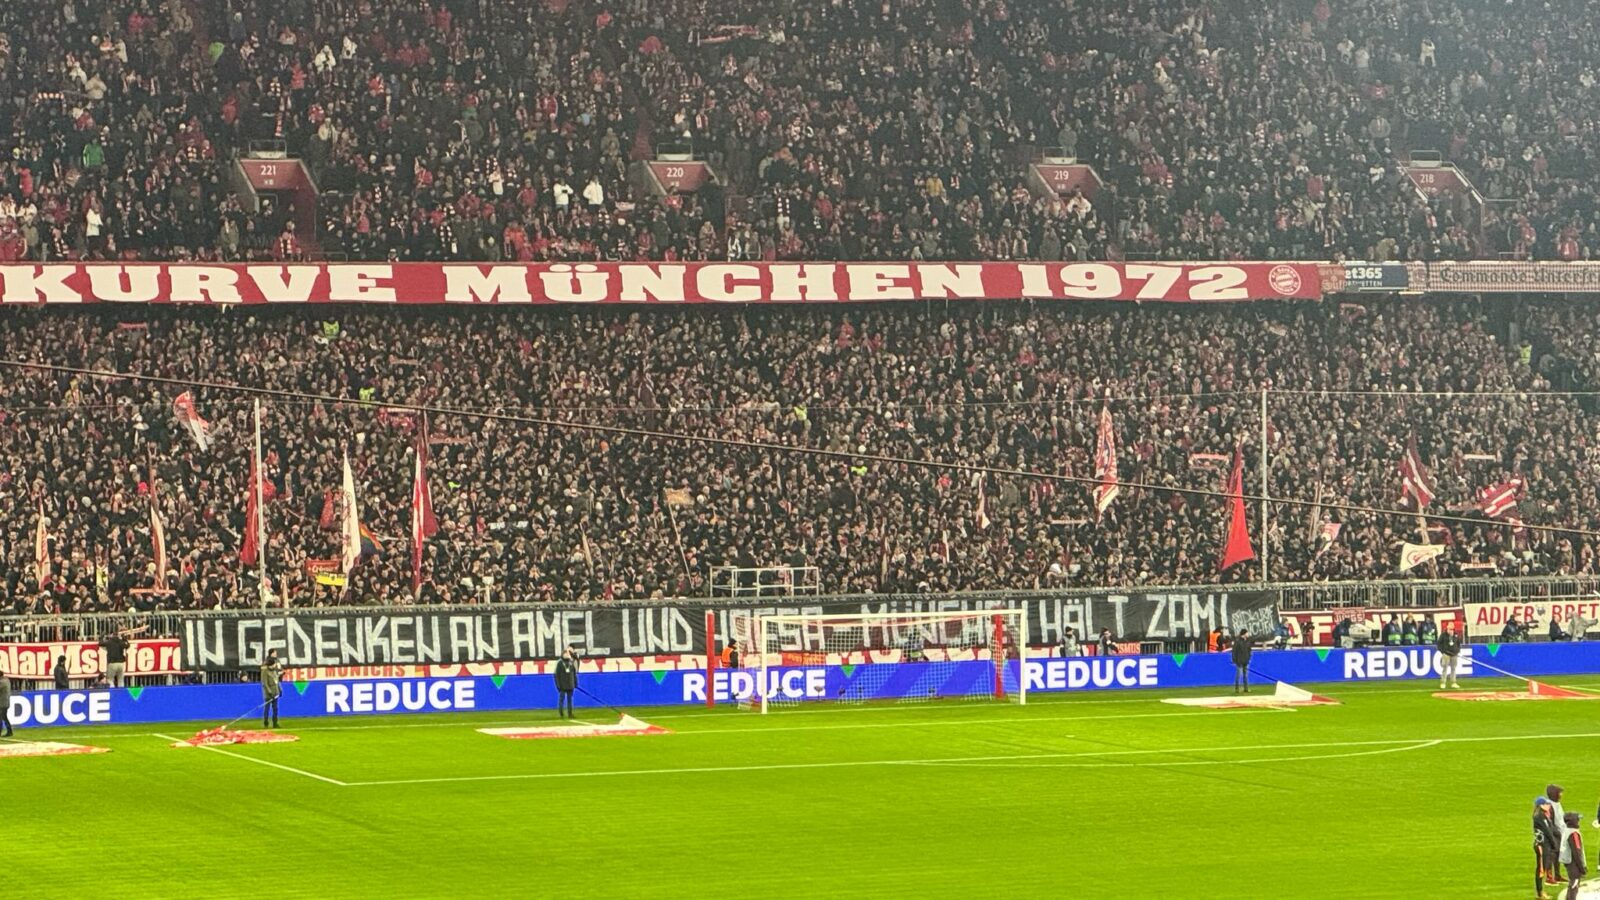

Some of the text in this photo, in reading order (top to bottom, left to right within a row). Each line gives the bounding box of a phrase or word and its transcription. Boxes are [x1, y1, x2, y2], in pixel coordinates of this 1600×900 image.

[260, 164, 277, 176] 221
[666, 167, 684, 178] 220
[1053, 170, 1069, 180] 219
[1419, 173, 1435, 184] 218
[0, 264, 397, 303] KURVE
[442, 263, 984, 303] MÜNCHEN
[1018, 263, 1249, 300] 1972
[1345, 267, 1383, 279] et365
[1477, 605, 1535, 626] ADLER
[185, 619, 226, 667] IN
[238, 614, 441, 667] GEDENKEN
[449, 614, 500, 663] AN
[511, 608, 610, 659] AMEL
[621, 606, 693, 655] UND
[1025, 658, 1158, 690] REDUCE
[683, 669, 826, 701] REDUCE
[326, 680, 475, 713] REDUCE
